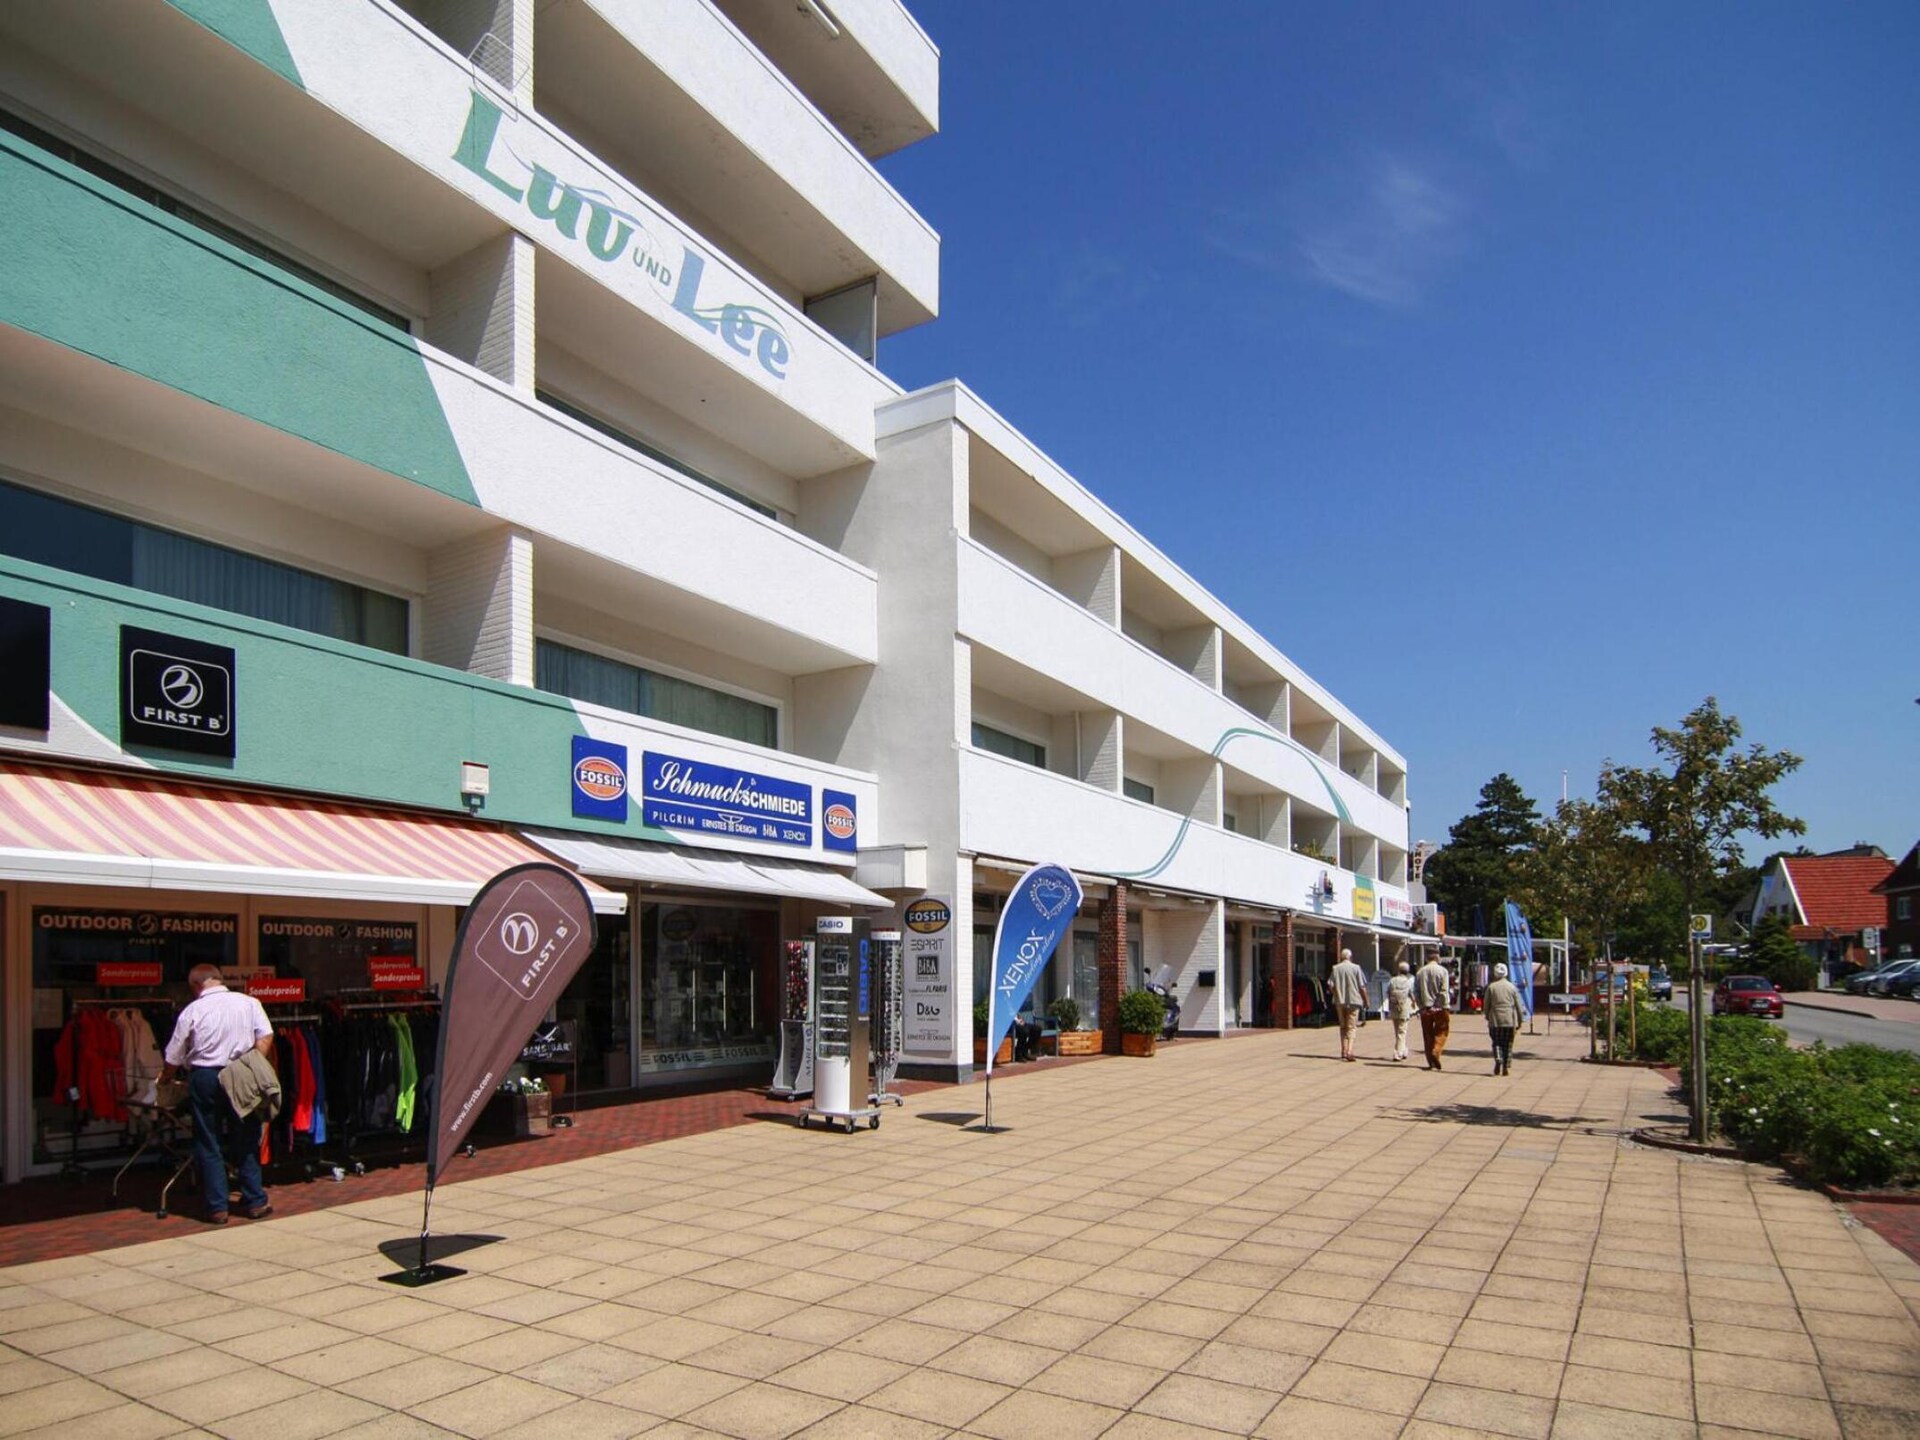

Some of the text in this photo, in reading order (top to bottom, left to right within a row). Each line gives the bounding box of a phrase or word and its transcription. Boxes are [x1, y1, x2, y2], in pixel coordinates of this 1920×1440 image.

[451, 87, 789, 380] Luv UND Lee
[143, 706, 221, 729] FIRST B
[580, 769, 622, 788] FOSSIL
[652, 811, 695, 826] PILGRIM
[735, 823, 757, 835] DESIGN
[828, 814, 854, 828] FOSSIL
[40, 914, 234, 933] OUTDOOR FASHION
[909, 911, 948, 921] FOSSIL
[262, 923, 413, 940] OUTDOOR FASHION
[819, 921, 844, 929] CASIO
[911, 938, 944, 951] ESPRIT
[522, 926, 568, 988] FIRST B
[998, 928, 1044, 998] XENOX
[374, 973, 421, 984] Sonderpreise
[249, 986, 300, 997] Sonderpreise
[916, 1002, 940, 1016] D&G
[654, 1052, 691, 1064] FOSSIL
[450, 1072, 493, 1132] www.firstb.com
